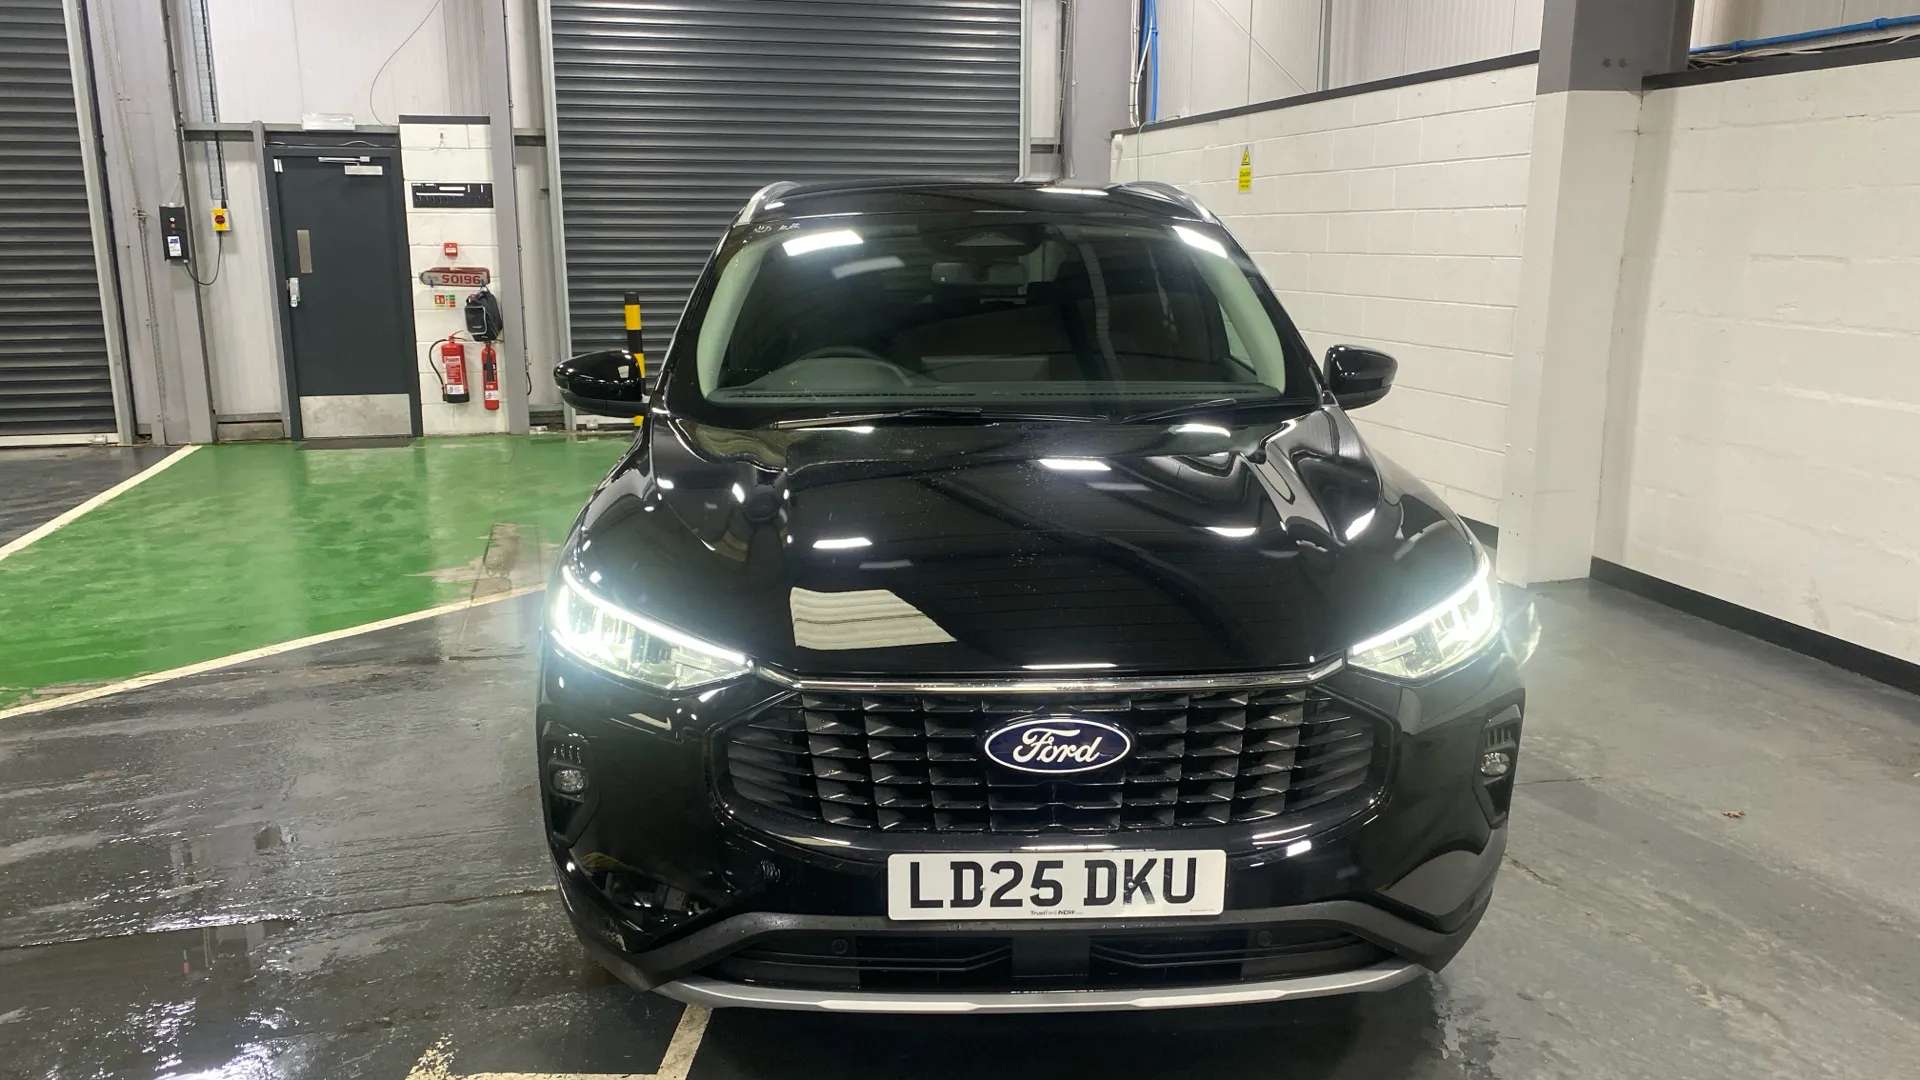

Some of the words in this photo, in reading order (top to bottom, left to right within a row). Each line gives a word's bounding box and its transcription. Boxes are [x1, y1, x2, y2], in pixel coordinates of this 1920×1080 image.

[1012, 727, 1101, 763] Ford
[909, 859, 1064, 909] LD25
[1083, 857, 1198, 907] DKU
